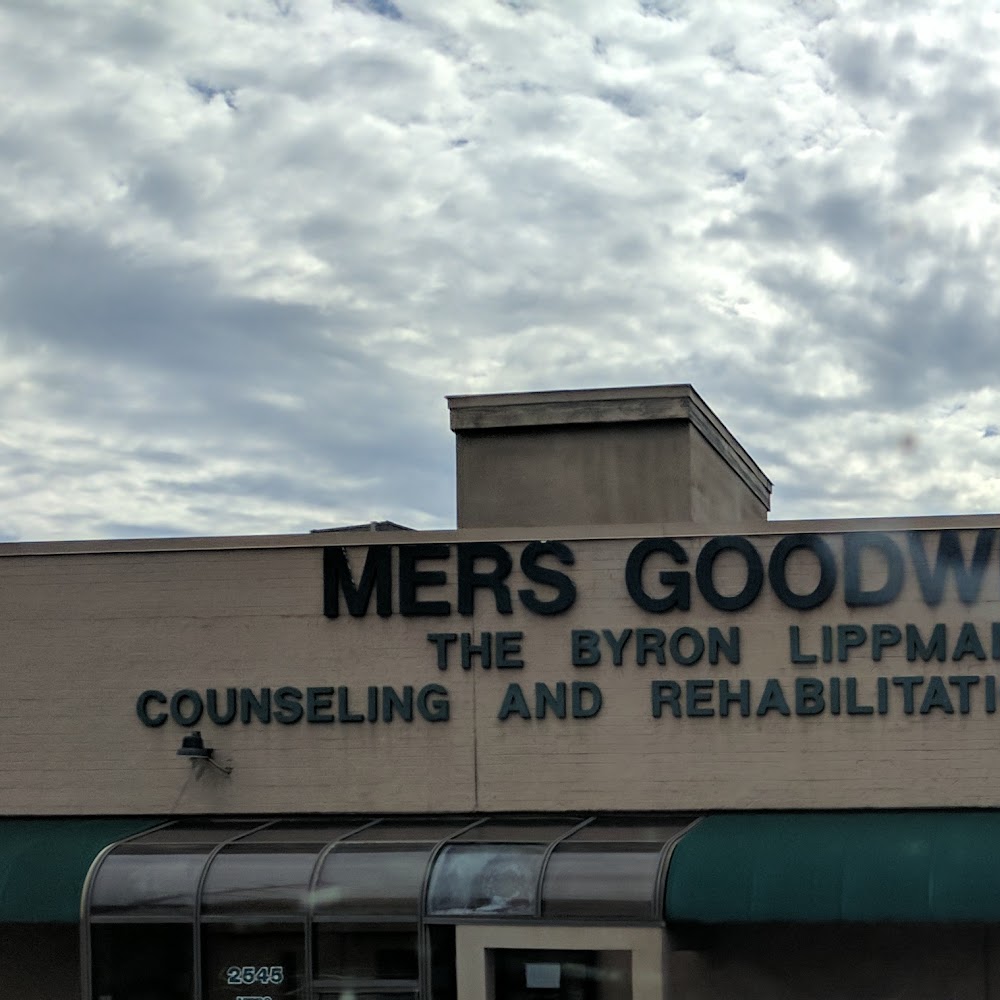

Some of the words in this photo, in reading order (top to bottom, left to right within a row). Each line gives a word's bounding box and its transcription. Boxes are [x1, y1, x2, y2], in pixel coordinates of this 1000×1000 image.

[322, 540, 578, 619] MERS
[427, 631, 525, 670] THE
[571, 627, 741, 668] BYRON
[136, 685, 451, 728] COUNSELING
[498, 680, 603, 720] AND
[226, 965, 284, 985] 2545
